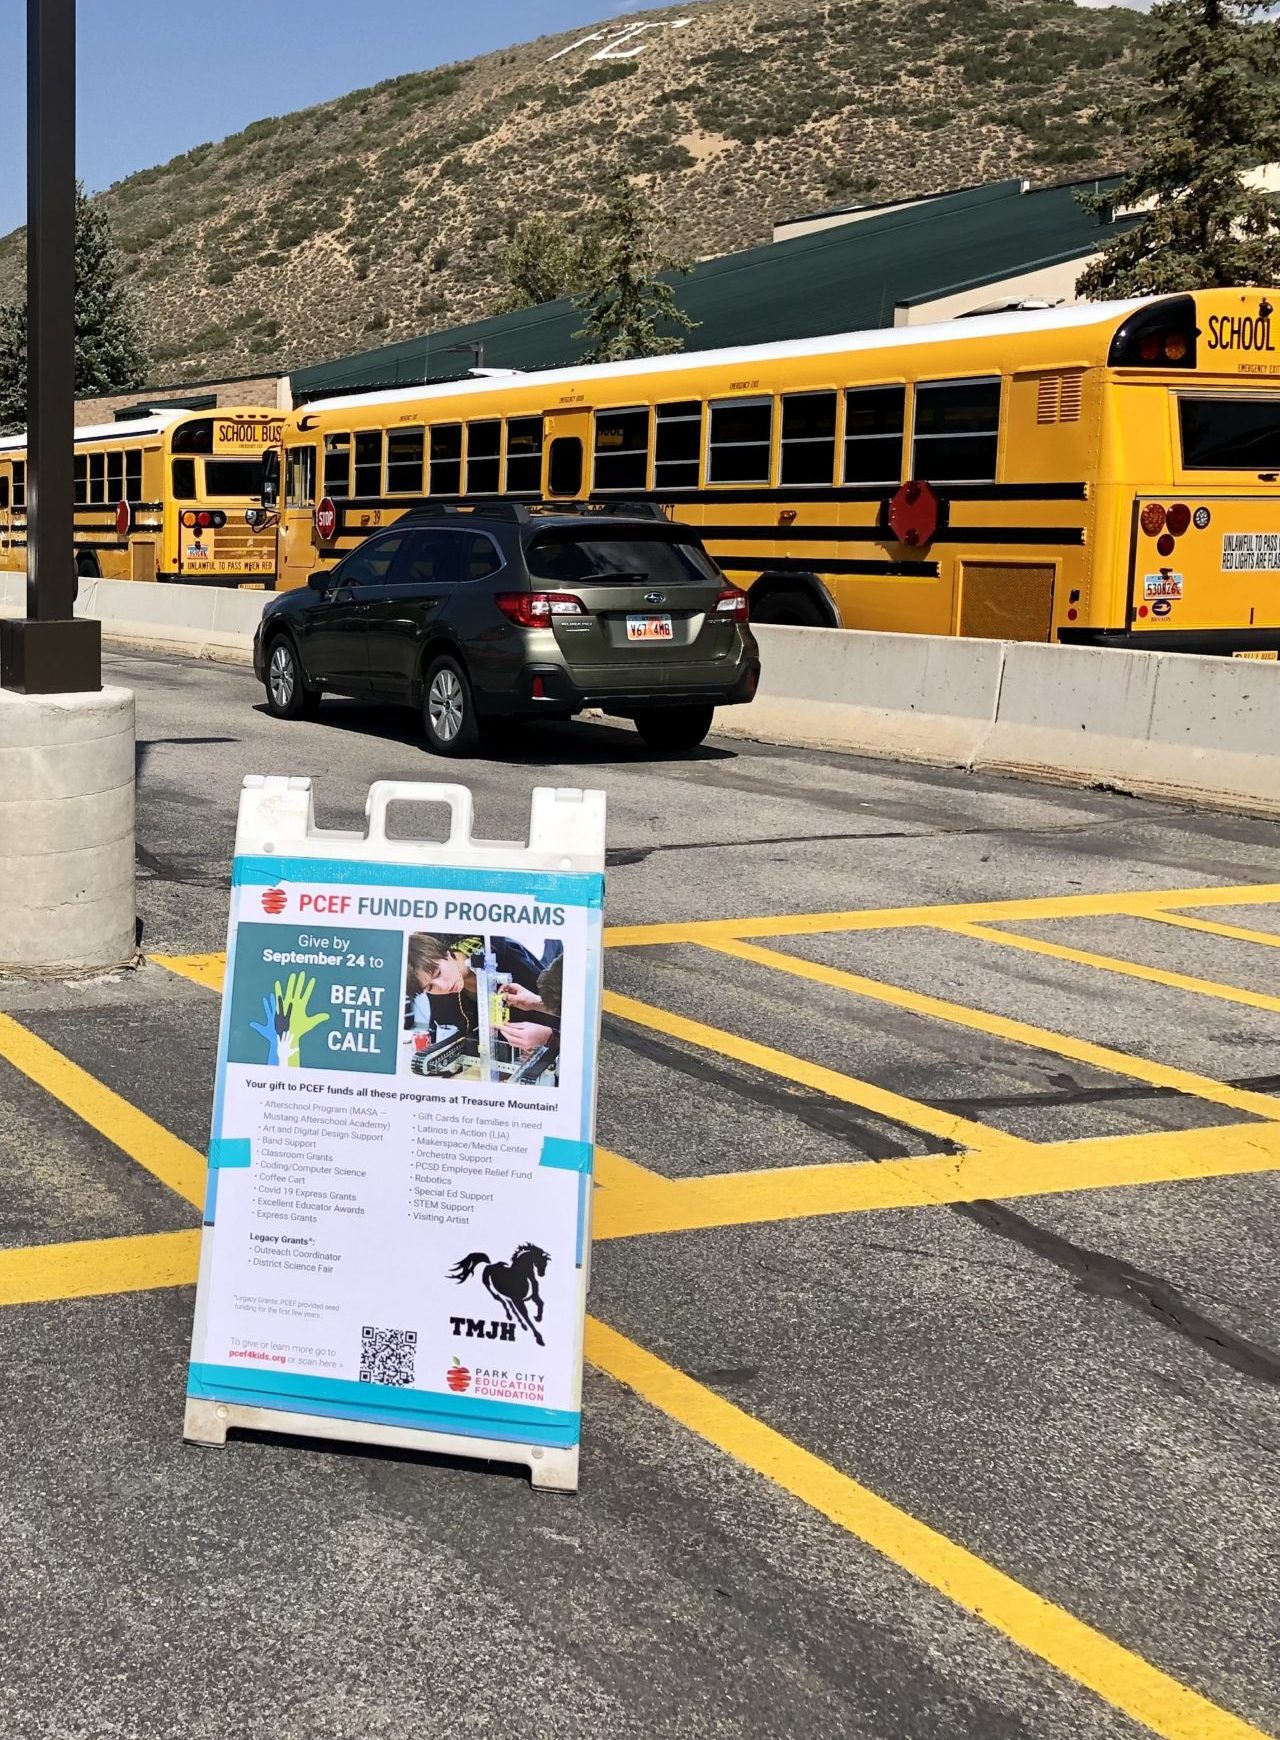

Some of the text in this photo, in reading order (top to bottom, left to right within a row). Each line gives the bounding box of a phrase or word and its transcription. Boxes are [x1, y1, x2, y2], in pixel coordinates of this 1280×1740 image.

[1208, 315, 1275, 351] SCHOOL
[219, 425, 282, 442] SCHOOL BUS
[319, 511, 334, 526] STOP
[1223, 534, 1278, 551] UNLAWFUL TO PASS
[187, 561, 216, 570] UNLAWFUL
[220, 561, 226, 570] TO
[228, 561, 241, 570] PASS
[262, 561, 273, 570] RED
[1222, 552, 1234, 569] RED
[1234, 552, 1254, 569] LIGHTS
[1254, 552, 1266, 569] ARE
[299, 893, 565, 925] PCEF FUNDED PROGRAMS
[298, 934, 350, 952] Give by
[262, 948, 383, 968] September 24 to
[330, 984, 385, 1006] BEAT
[341, 1008, 383, 1030] THE
[327, 1030, 380, 1053] CALL
[245, 1079, 267, 1088] Your
[269, 1081, 285, 1091] gift
[299, 1083, 324, 1092] PCEF
[327, 1085, 353, 1095] funds
[356, 1087, 367, 1096] all
[370, 1089, 397, 1099] these
[399, 1093, 446, 1103] programs
[461, 1095, 505, 1107] Treasure
[507, 1099, 558, 1111] Mountain!
[264, 1100, 310, 1111] Afterschool
[312, 1103, 347, 1114] Program
[263, 1111, 390, 1131] Mustang Afterschool Academy)
[418, 1112, 432, 1121] Gift
[435, 1113, 459, 1123] Cards
[461, 1115, 473, 1124] for
[476, 1117, 509, 1127] families
[262, 1124, 383, 1142] Art and Digital Design Support
[417, 1124, 509, 1141] Latinos in Action (LIA)
[262, 1136, 316, 1148] Band Support
[416, 1136, 528, 1153] Makerspace/Media Center
[261, 1148, 333, 1161] Classroom Grants
[416, 1149, 492, 1163] Orchestra Support
[260, 1160, 366, 1177] Coding/Computer Science
[415, 1161, 532, 1179] PCSD Employee Relief Fund
[259, 1172, 305, 1184] Coffee Cart
[414, 1174, 452, 1185] Robotics
[258, 1184, 356, 1201] Covid 19 Express Grants
[414, 1186, 493, 1201] Special Ed Support
[257, 1197, 364, 1214] Excellent Educator Awards
[413, 1199, 474, 1212] STEM Support
[256, 1209, 317, 1222] Express Grants
[413, 1211, 469, 1224] Visiting Artist
[249, 1232, 279, 1244] Legacy
[253, 1245, 341, 1261] Outreach Coordinator
[253, 1257, 333, 1272] District Science Fair
[280, 1298, 296, 1306] PCEF
[449, 1316, 516, 1341] TMJH
[230, 1337, 240, 1345] To
[242, 1339, 258, 1348] give
[270, 1341, 290, 1351] learn
[292, 1345, 313, 1353] more
[314, 1348, 326, 1356] go
[327, 1348, 336, 1356] to
[229, 1350, 286, 1363] pcef4kids.org
[297, 1357, 317, 1365] scan
[318, 1359, 336, 1368] here
[475, 1368, 544, 1382] PARK CITY
[475, 1377, 544, 1391] EDUCATION
[474, 1386, 543, 1401] FOUNDATION
